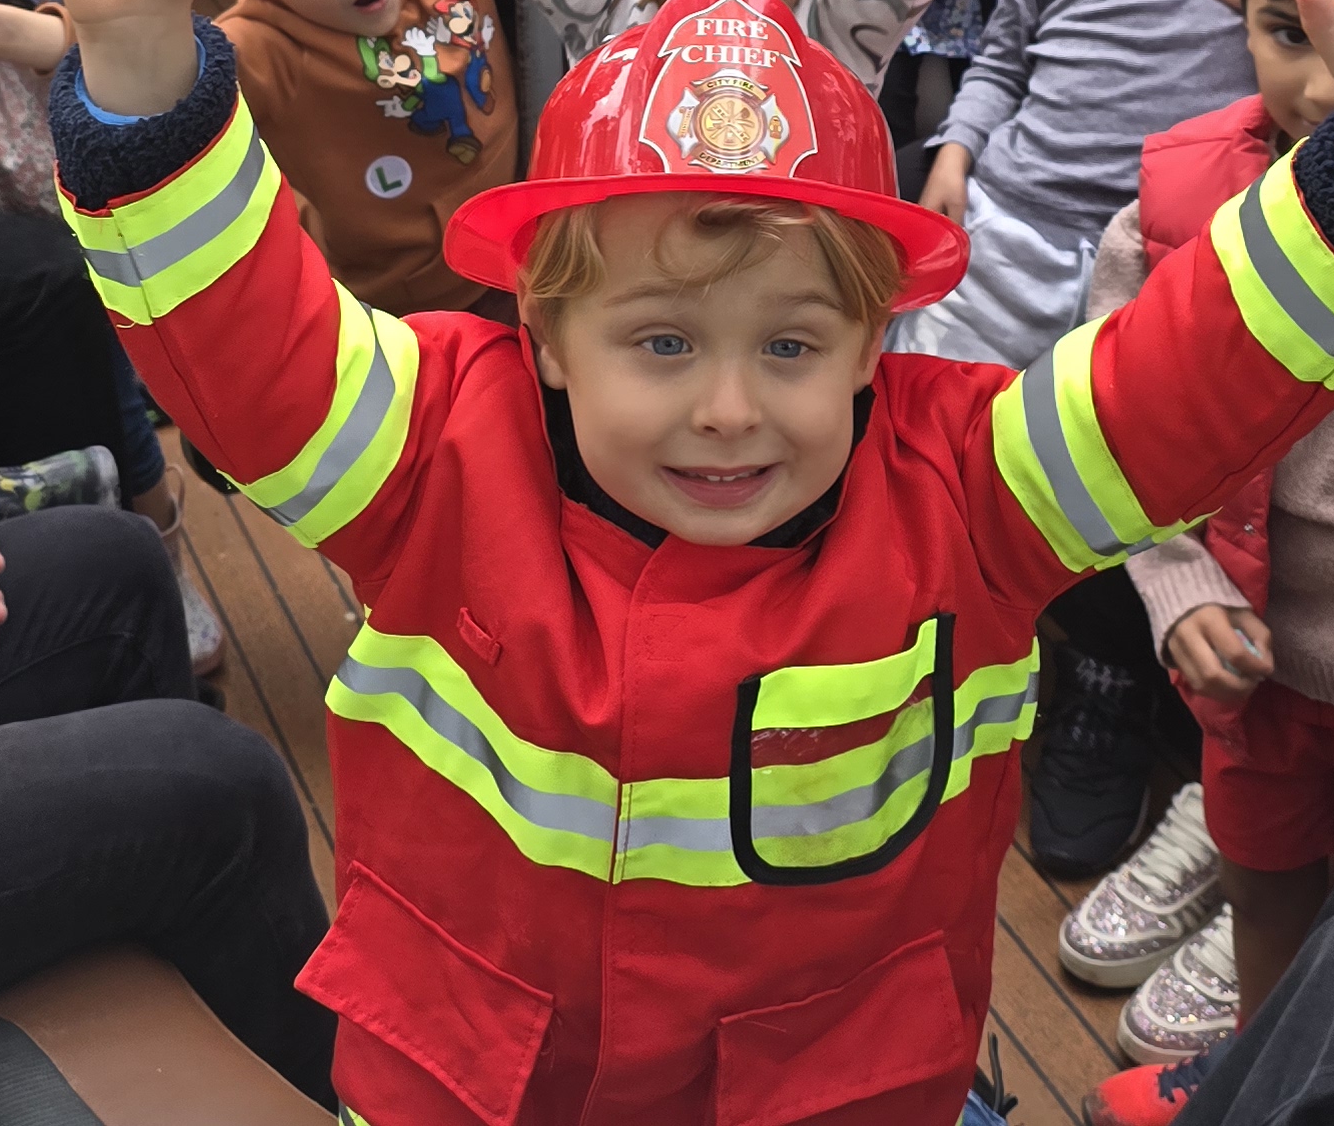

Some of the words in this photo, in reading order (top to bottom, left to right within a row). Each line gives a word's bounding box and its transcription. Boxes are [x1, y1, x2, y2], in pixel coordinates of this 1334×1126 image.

[695, 18, 769, 40] FIRE
[680, 44, 780, 68] CHIEF
[706, 78, 730, 89] CITY
[732, 79, 755, 91] FIRE
[375, 166, 403, 193] L
